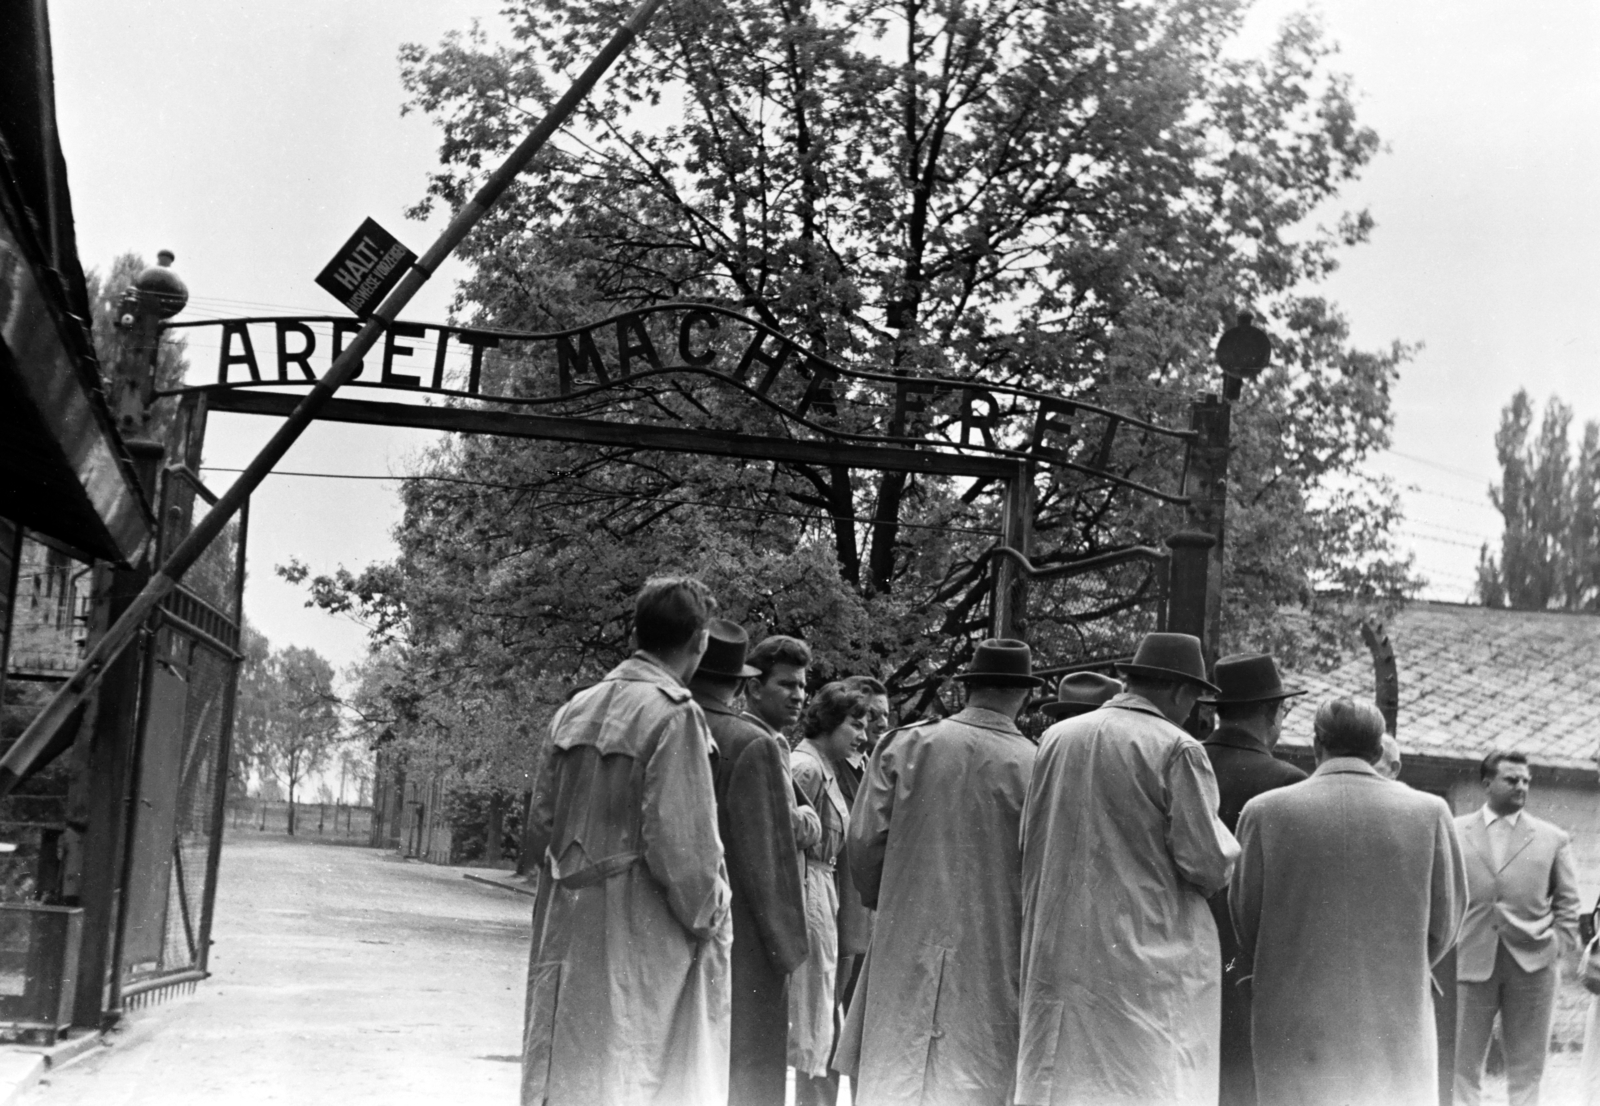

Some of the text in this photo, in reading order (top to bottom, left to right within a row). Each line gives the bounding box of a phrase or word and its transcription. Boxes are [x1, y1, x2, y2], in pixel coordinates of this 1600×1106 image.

[333, 235, 384, 291] HALT!
[346, 273, 382, 313] AUSWEISE
[218, 308, 1119, 470] ARBEIT MACHT FREI
